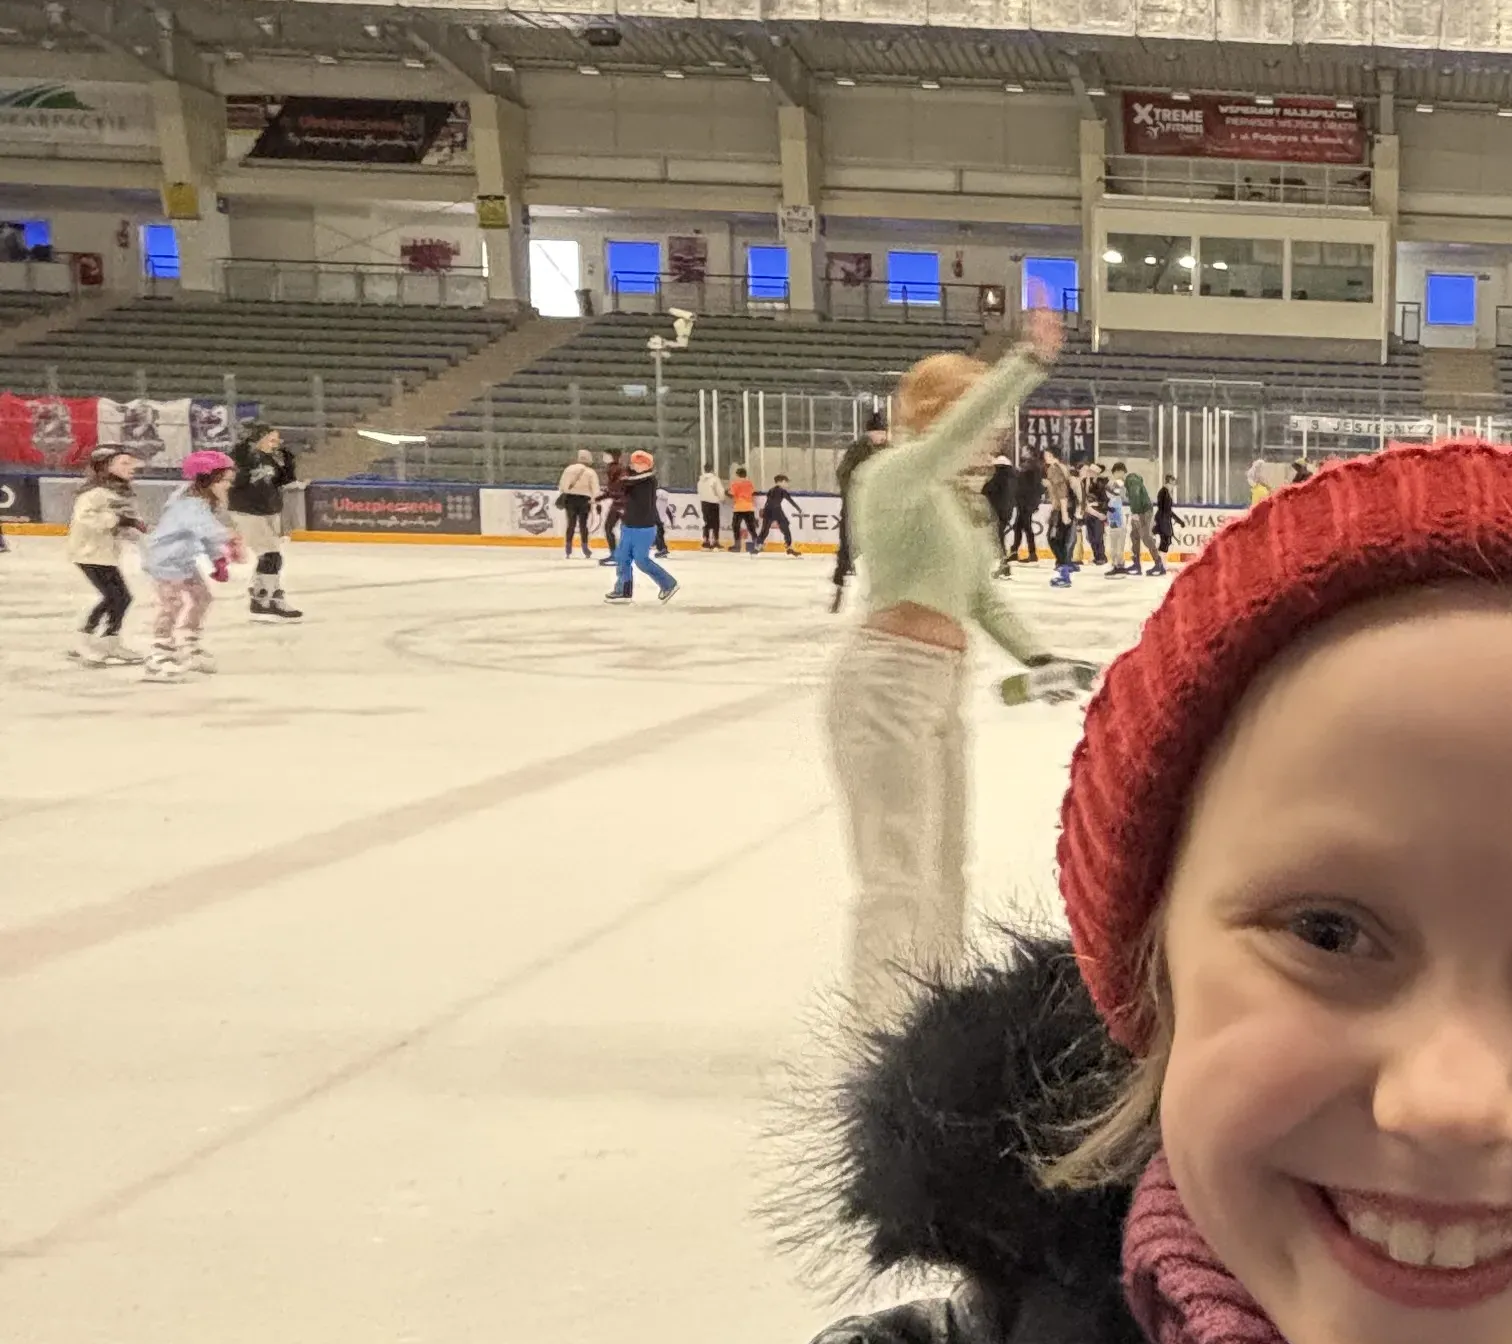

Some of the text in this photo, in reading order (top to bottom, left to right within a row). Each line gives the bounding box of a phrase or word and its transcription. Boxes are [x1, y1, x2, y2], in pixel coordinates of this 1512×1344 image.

[1132, 102, 1204, 125] XTREME
[1028, 435, 1085, 452] RAZM
[792, 513, 843, 531] TEX
